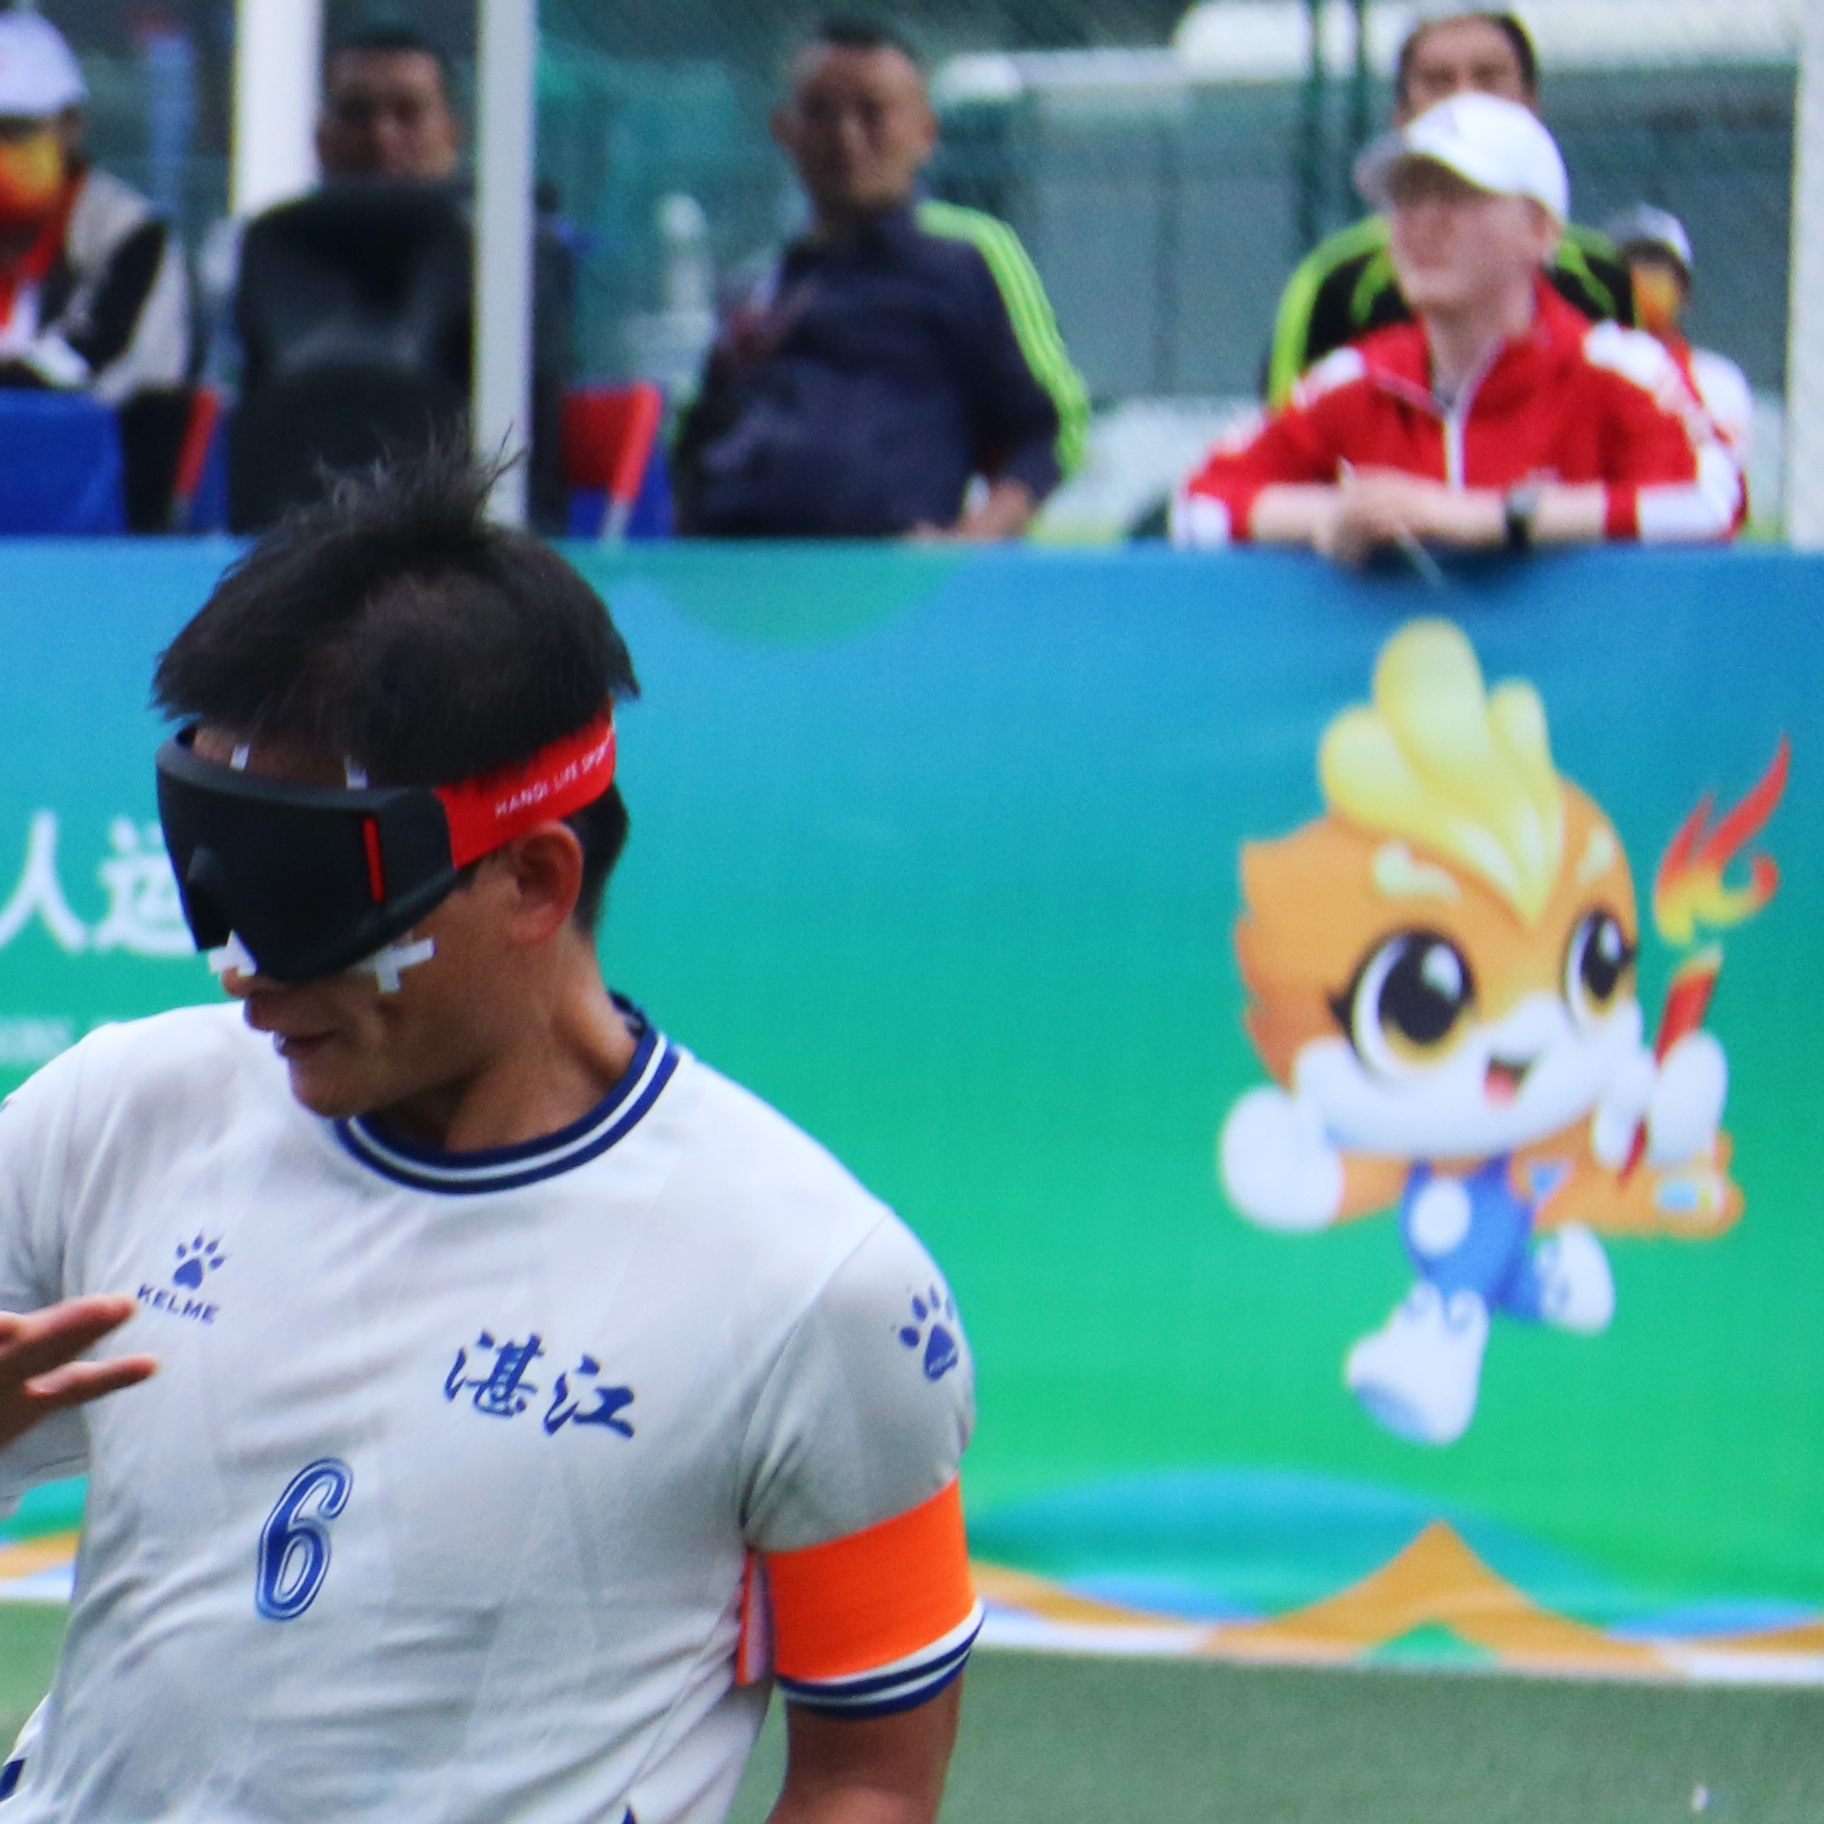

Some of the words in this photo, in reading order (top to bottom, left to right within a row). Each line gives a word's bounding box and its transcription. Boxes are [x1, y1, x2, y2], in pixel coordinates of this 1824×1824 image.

[137, 1283, 222, 1325] KELME
[443, 1330, 637, 1440] 湛江
[256, 1457, 353, 1622] 6
